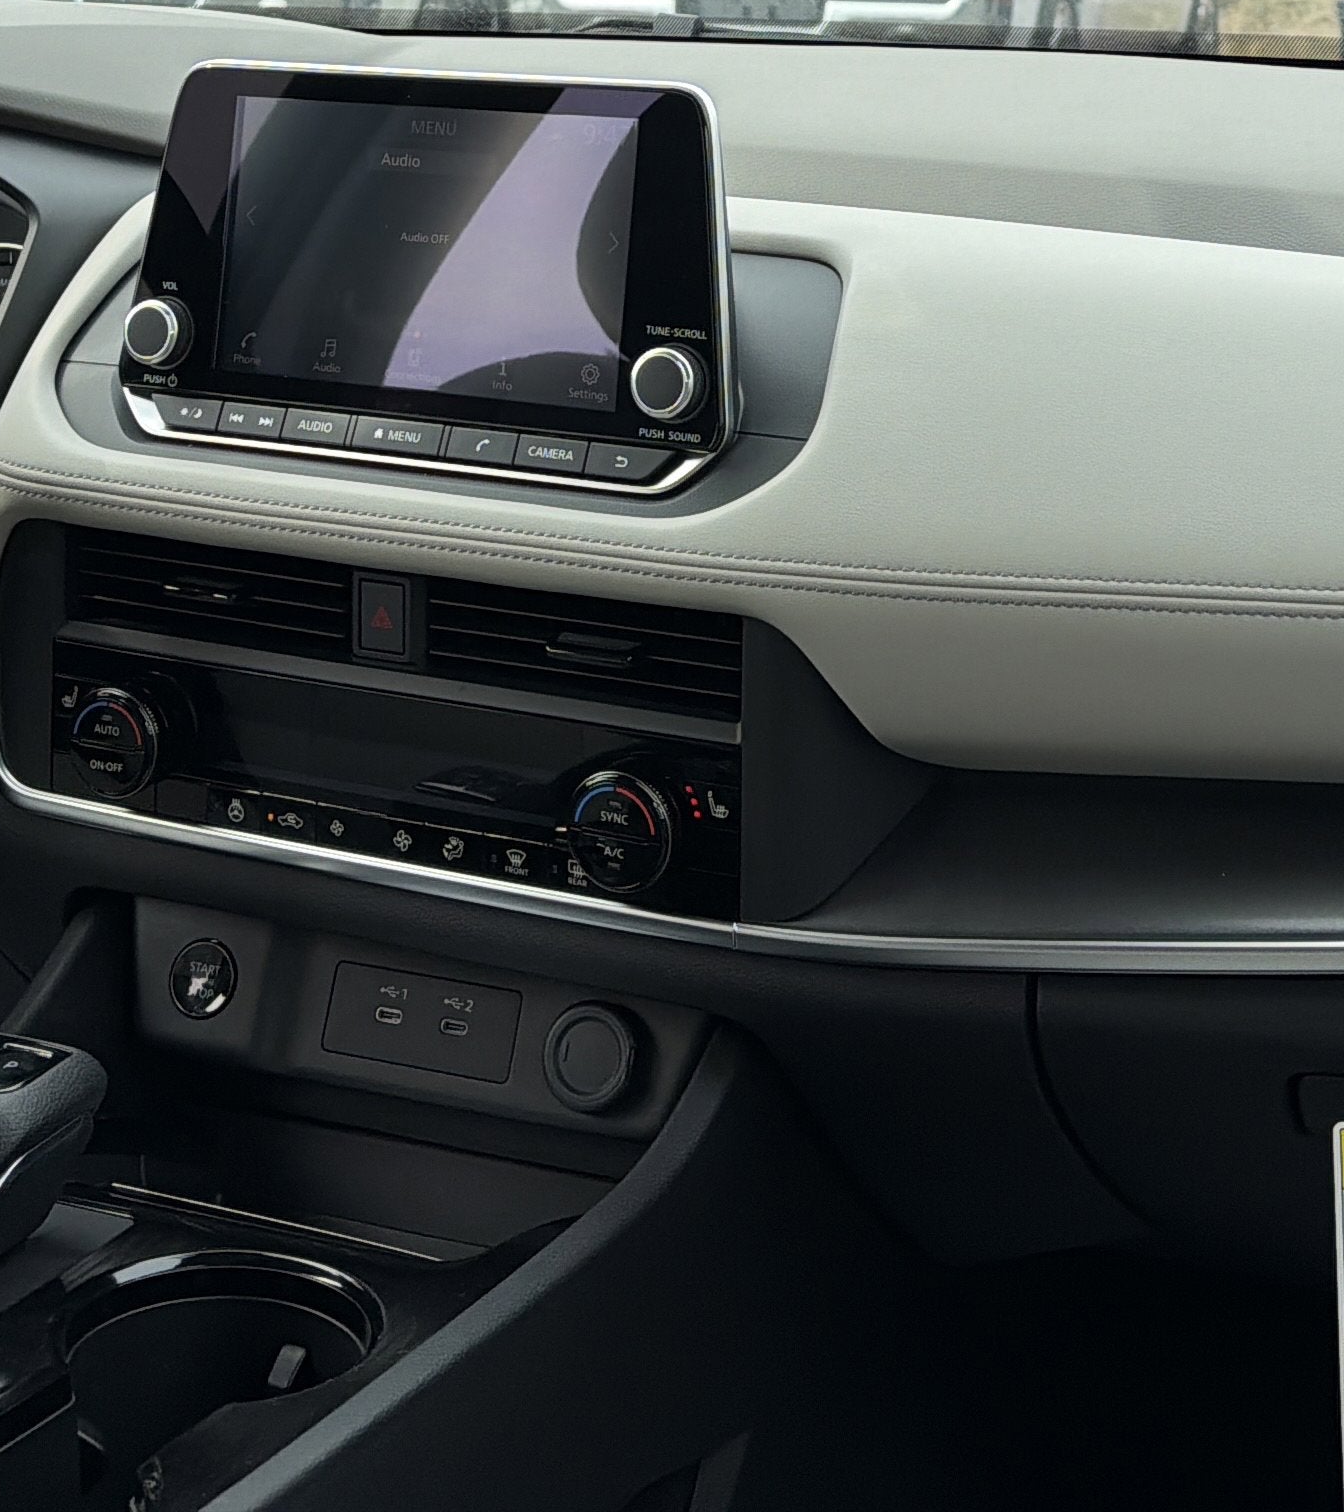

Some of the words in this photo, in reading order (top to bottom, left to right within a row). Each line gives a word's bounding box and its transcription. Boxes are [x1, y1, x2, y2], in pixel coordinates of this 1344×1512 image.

[411, 120, 457, 137] MENU
[381, 152, 421, 168] Audio
[400, 232, 429, 244] Audio
[430, 233, 450, 244] OFF
[162, 281, 178, 290] VOL
[143, 373, 166, 384] PUSH
[233, 353, 261, 366] Phone
[312, 361, 341, 374] Audio
[492, 380, 513, 392] Info
[568, 387, 609, 402] Settings
[297, 419, 333, 433] AUDIO
[388, 430, 422, 443] MENU
[527, 446, 574, 461] CAMERA
[638, 427, 665, 439] PUSH
[668, 431, 701, 443] SOUND
[94, 723, 121, 737] AUTO
[600, 811, 629, 826] SYNC
[603, 846, 624, 860] A/C
[504, 865, 529, 877] FRONT
[189, 961, 222, 977] START
[464, 999, 474, 1013] 2
[2, 1060, 19, 1070] P
